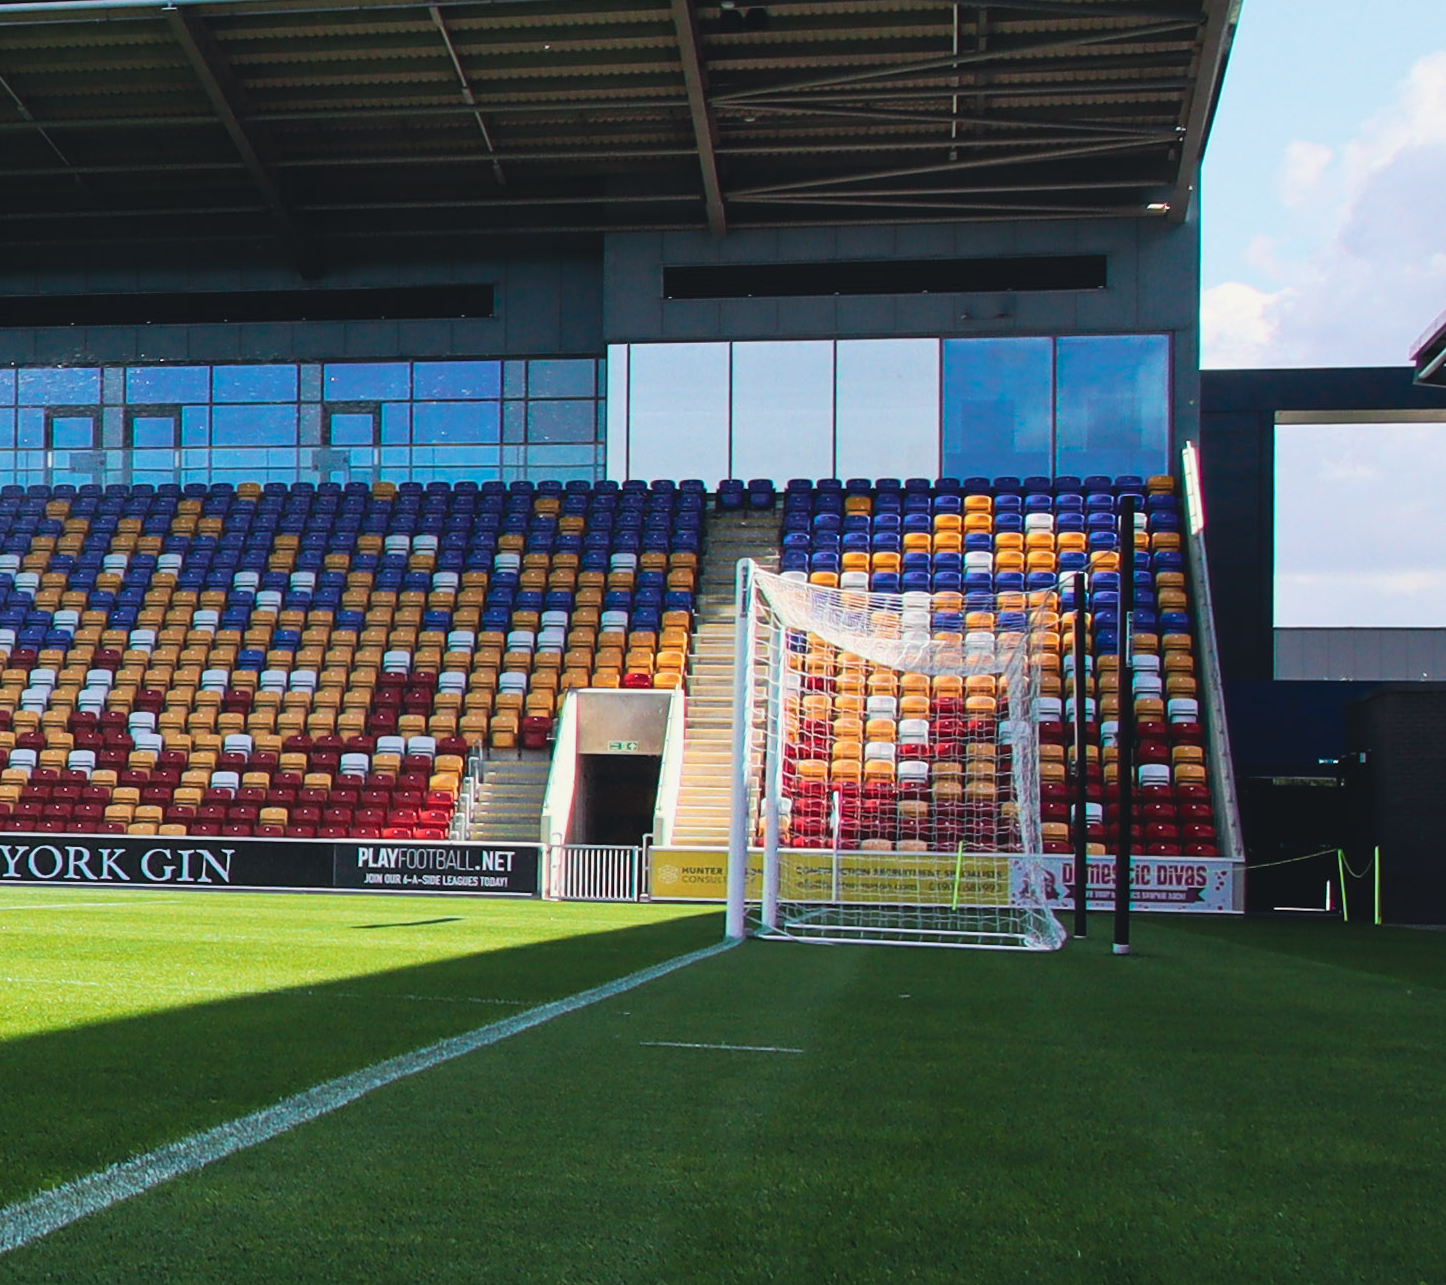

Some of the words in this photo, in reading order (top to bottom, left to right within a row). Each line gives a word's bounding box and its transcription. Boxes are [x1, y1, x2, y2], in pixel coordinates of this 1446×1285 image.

[140, 848, 236, 883] GIN
[357, 847, 516, 872] PLAYFOOTBALL.NET
[364, 873, 383, 883] JOIN
[384, 874, 402, 884] OUR
[402, 874, 441, 886] 6-A-SIDE
[442, 875, 479, 887] LEAGUES
[480, 876, 509, 887] TODAY!
[682, 867, 723, 875] HUNTER
[944, 869, 1002, 879] SPCIALISTS
[1062, 863, 1150, 886] Dmesic
